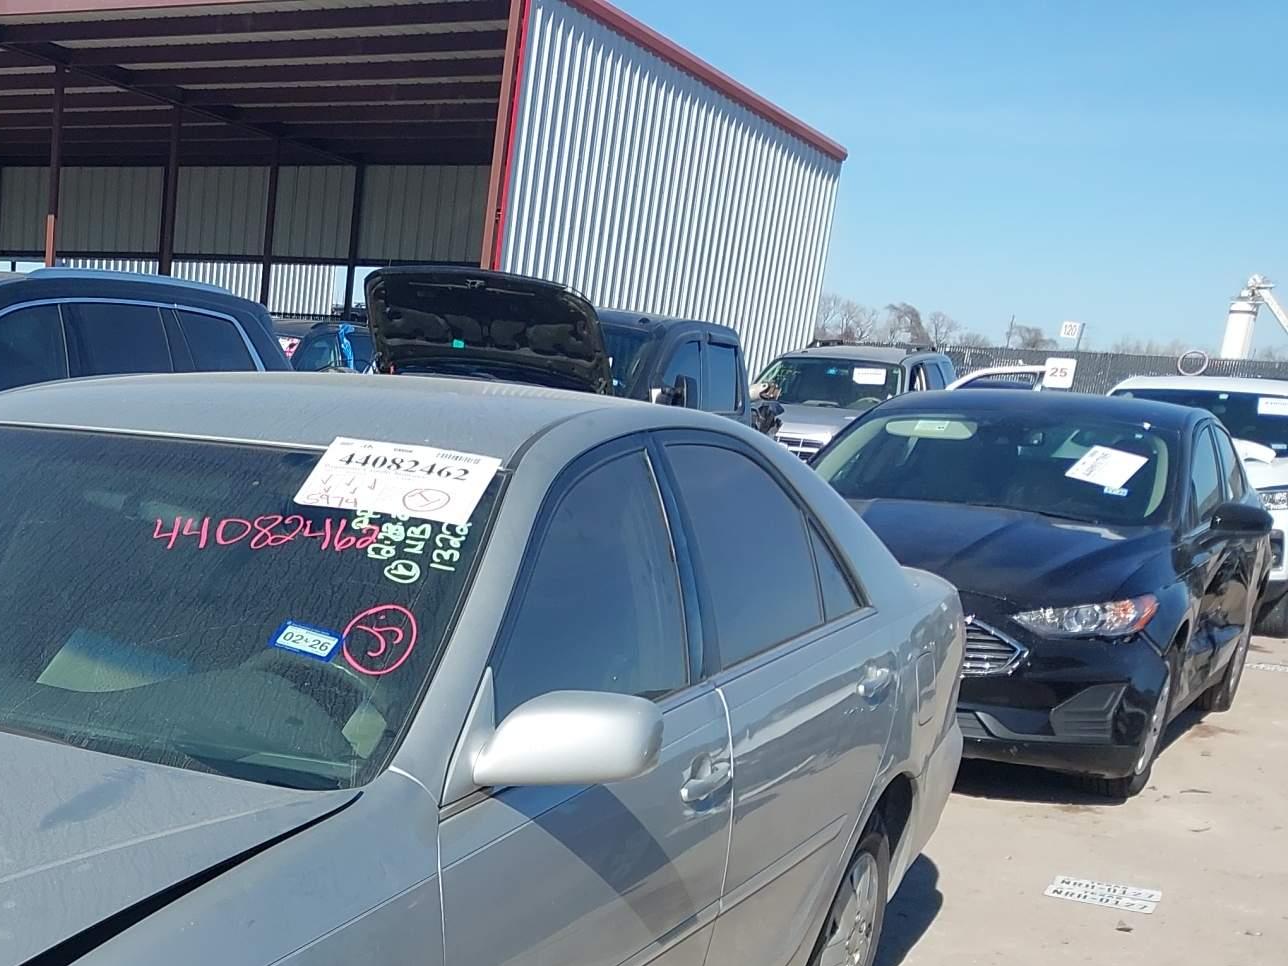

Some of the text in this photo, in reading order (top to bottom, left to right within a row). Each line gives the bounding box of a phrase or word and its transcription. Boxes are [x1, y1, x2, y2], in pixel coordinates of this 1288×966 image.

[1049, 367, 1068, 377] 25
[339, 452, 470, 481] 44082462
[152, 515, 380, 551] 44082462
[282, 631, 331, 652] 02 26
